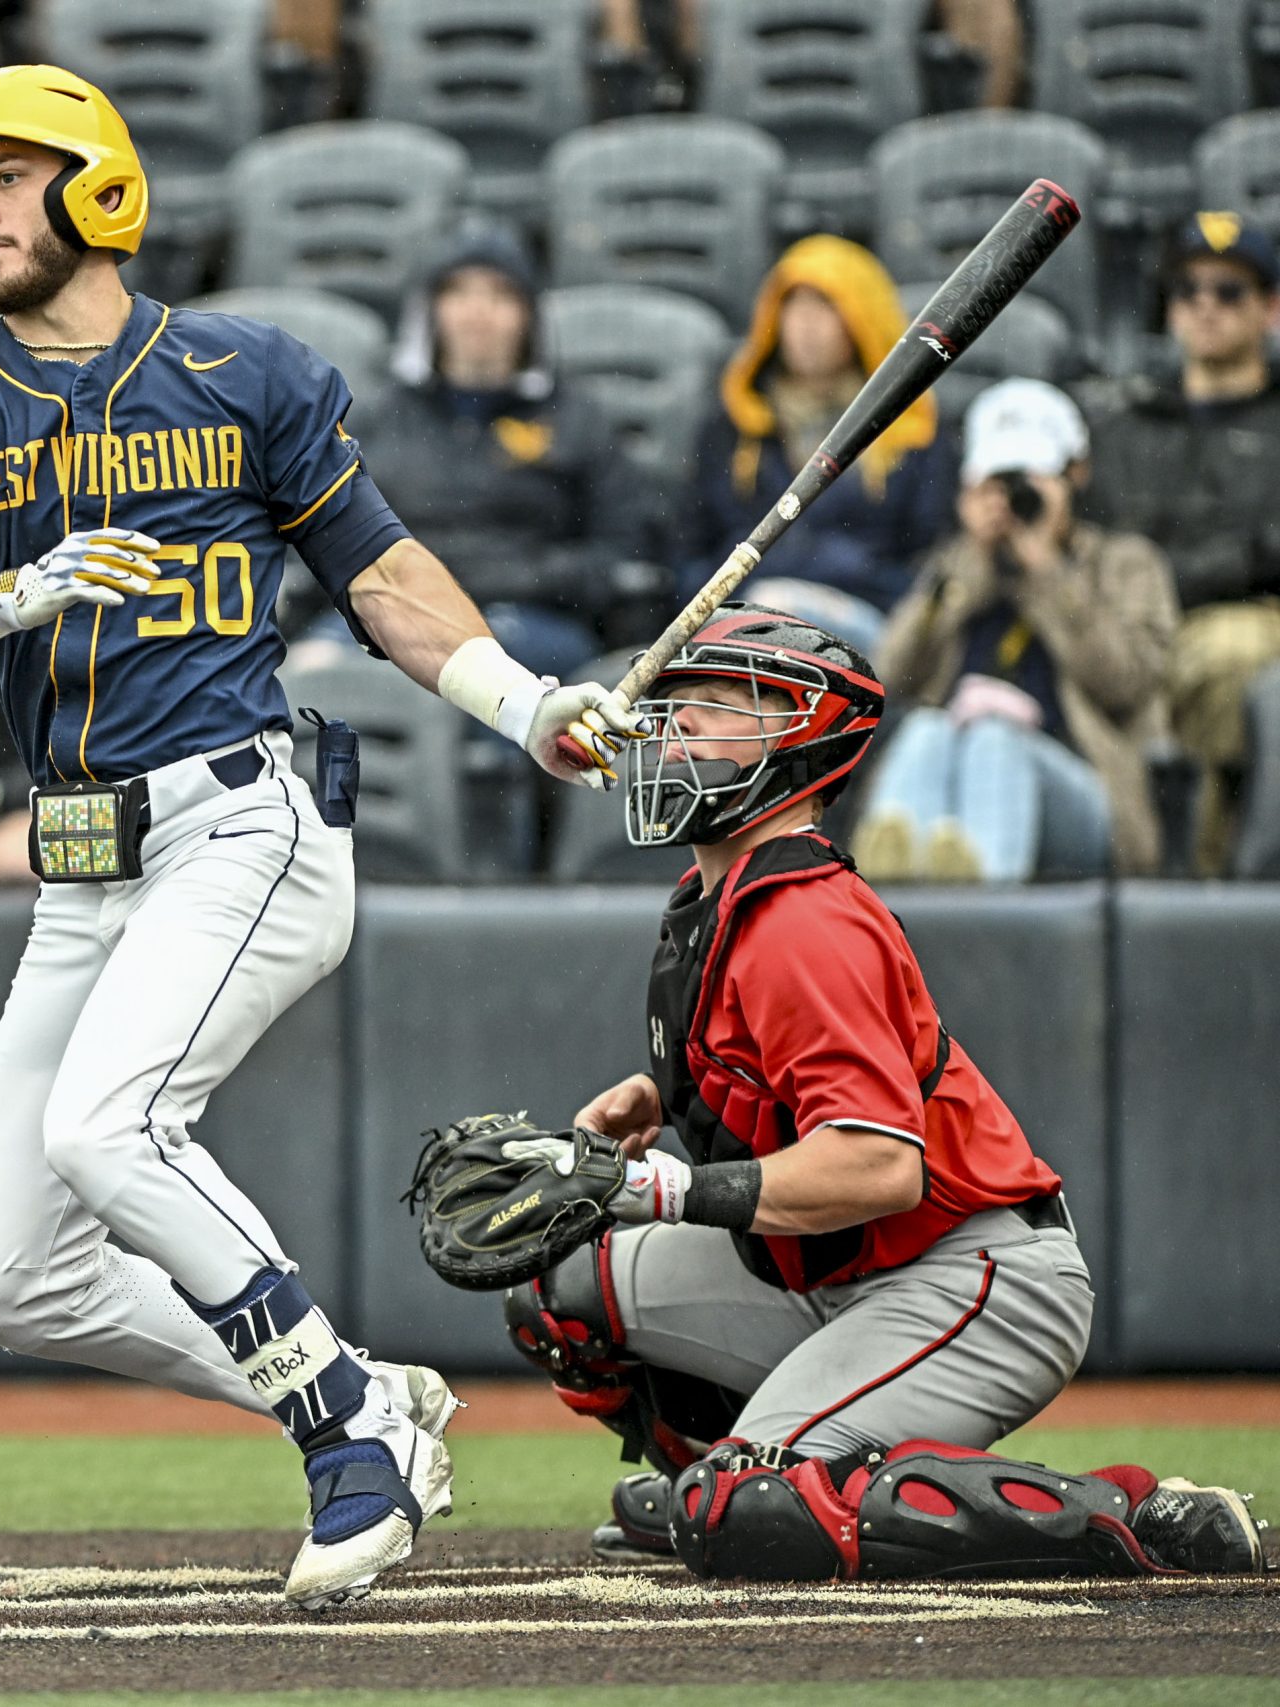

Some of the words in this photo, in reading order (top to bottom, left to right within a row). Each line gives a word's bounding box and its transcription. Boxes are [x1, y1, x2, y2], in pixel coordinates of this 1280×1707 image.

[51, 426, 242, 496] VIRGINIA
[137, 541, 254, 637] 50
[247, 1365, 274, 1391] MY
